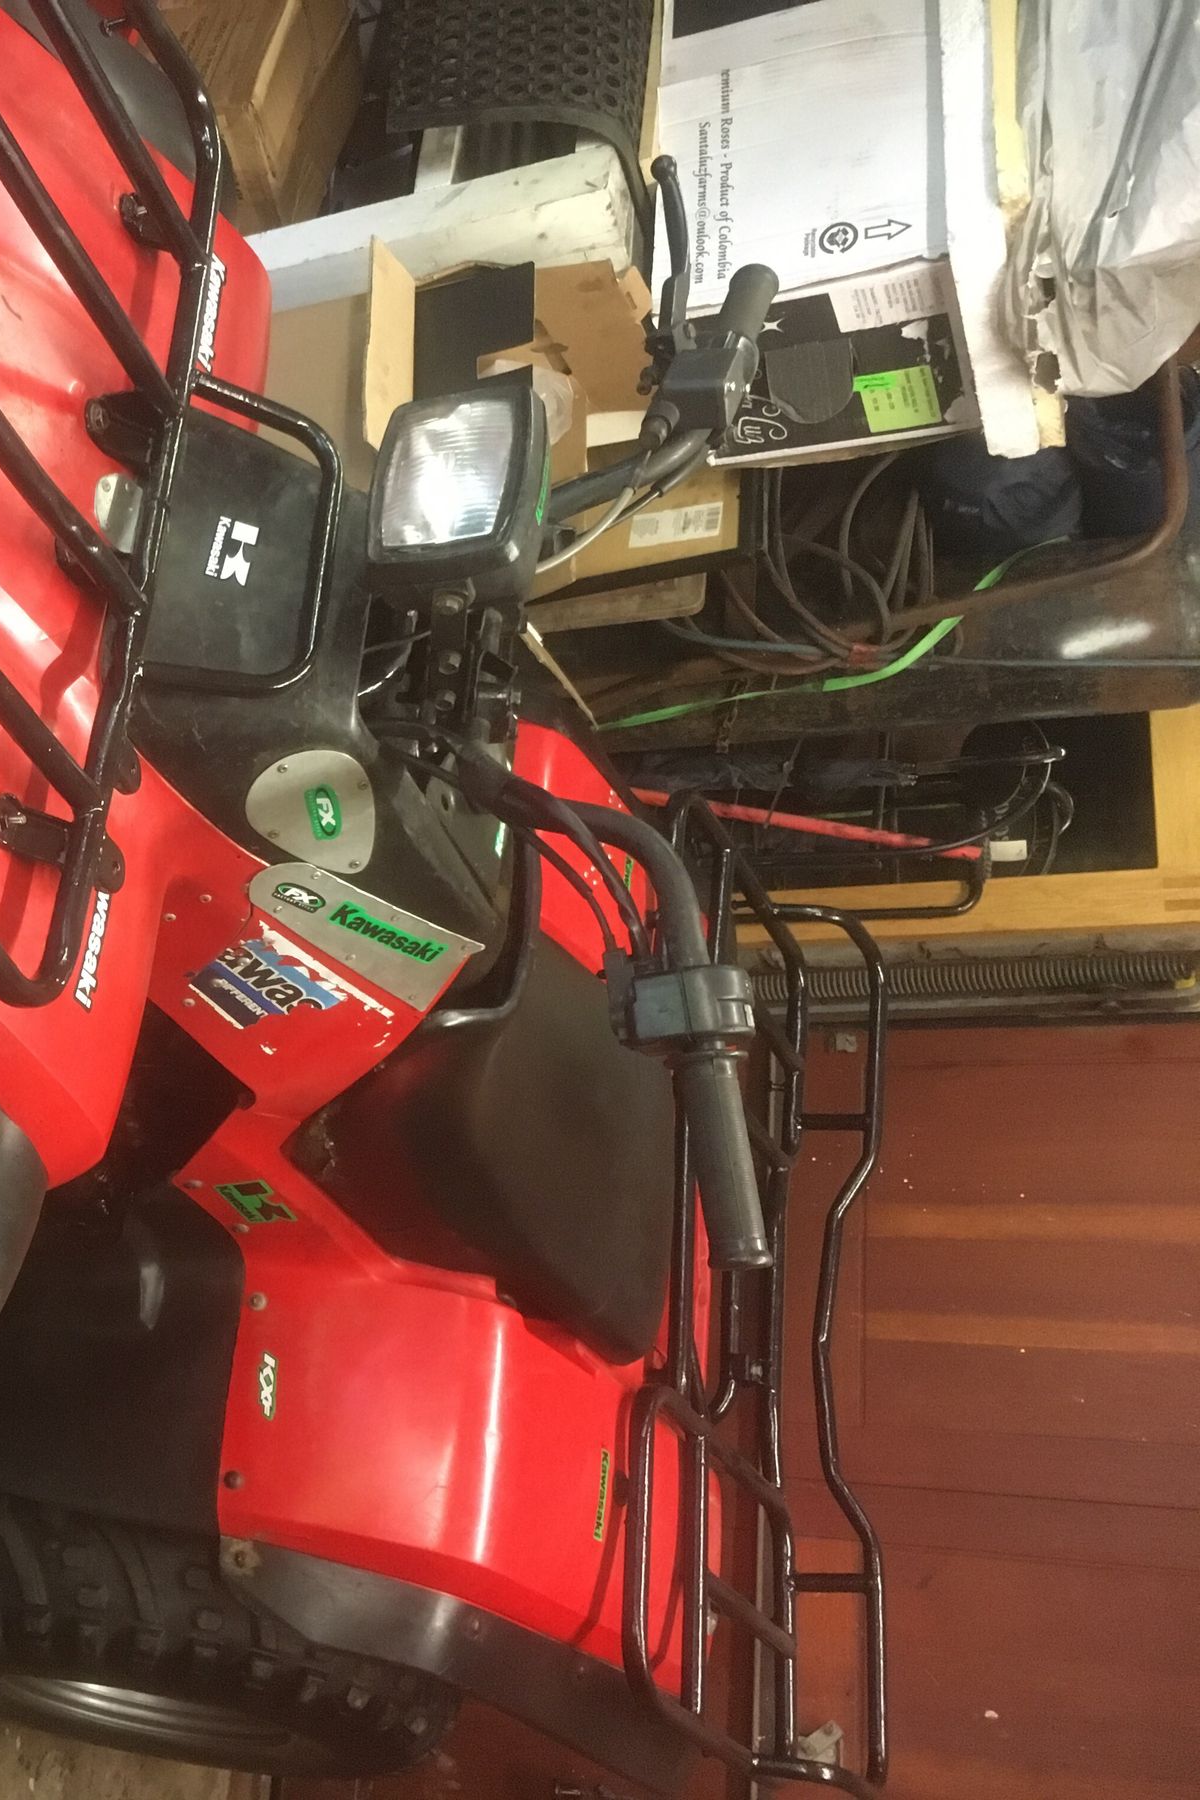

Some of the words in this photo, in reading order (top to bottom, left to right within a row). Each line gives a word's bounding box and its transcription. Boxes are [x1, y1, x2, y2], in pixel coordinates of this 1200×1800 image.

[720, 117, 733, 150] Roses
[720, 162, 734, 207] Product
[713, 210, 734, 223] of
[717, 225, 734, 280] Colombia
[197, 253, 225, 373] Kawasaki
[205, 516, 232, 577] Kawasaki
[316, 797, 336, 827] FX
[284, 888, 318, 906] FX
[331, 905, 445, 964] Kawasaki
[594, 1450, 609, 1539] Kawasaki
